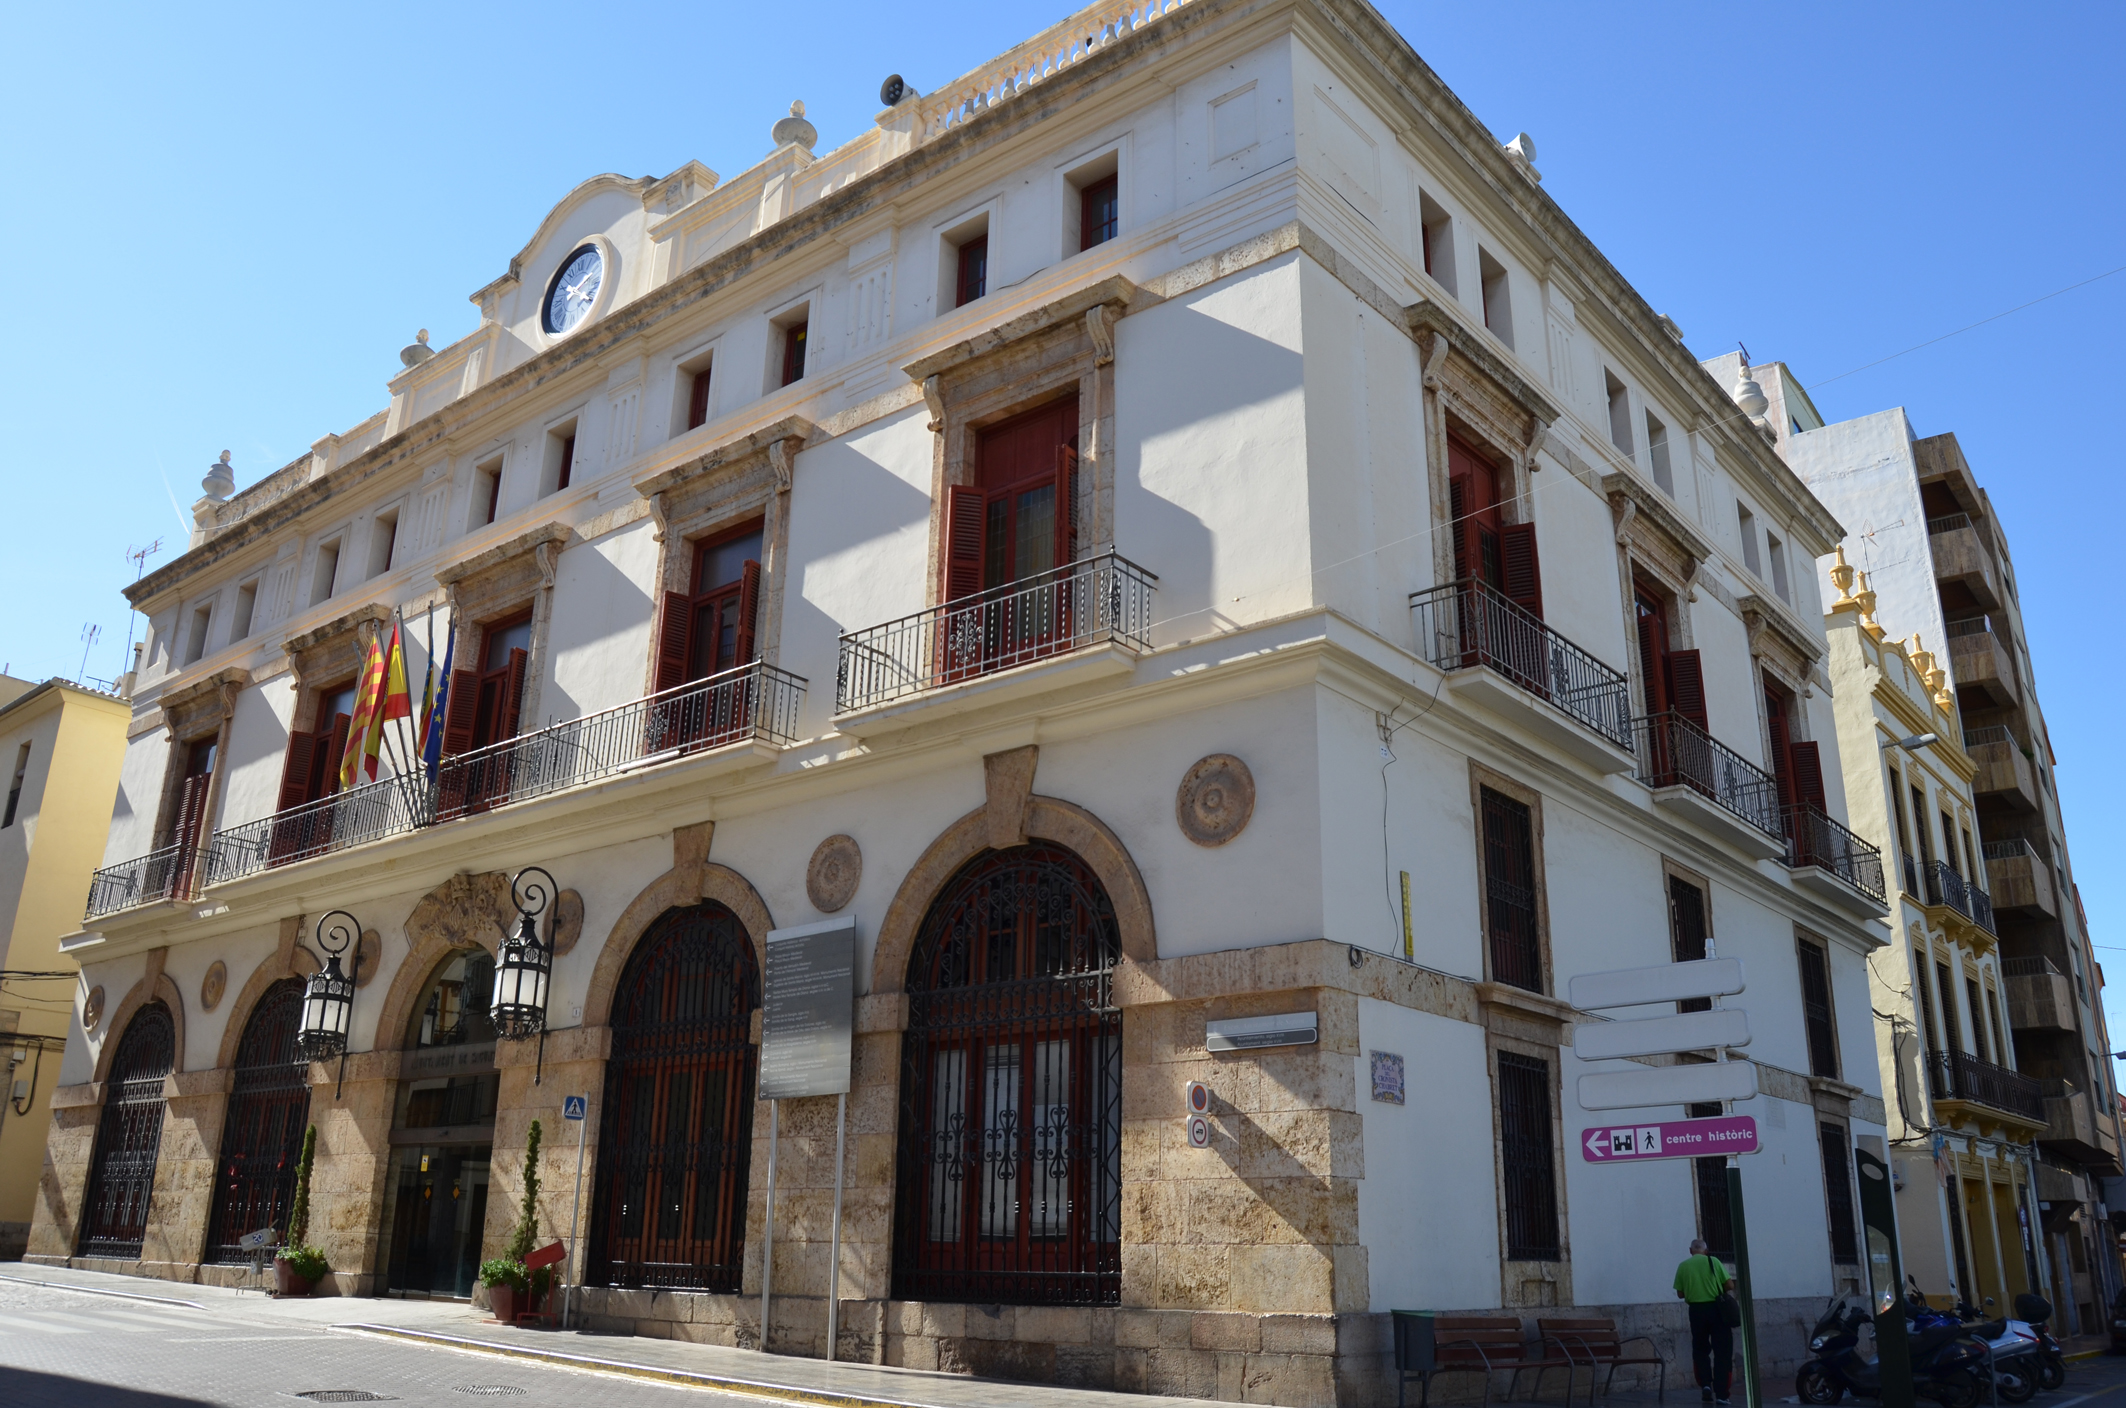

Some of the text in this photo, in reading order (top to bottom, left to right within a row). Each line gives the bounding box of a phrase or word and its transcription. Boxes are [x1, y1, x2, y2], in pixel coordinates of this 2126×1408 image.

[1378, 1075, 1398, 1084] CRONISTA
[1666, 1129, 1752, 1144] centre històric
[253, 1233, 263, 1243] 20
